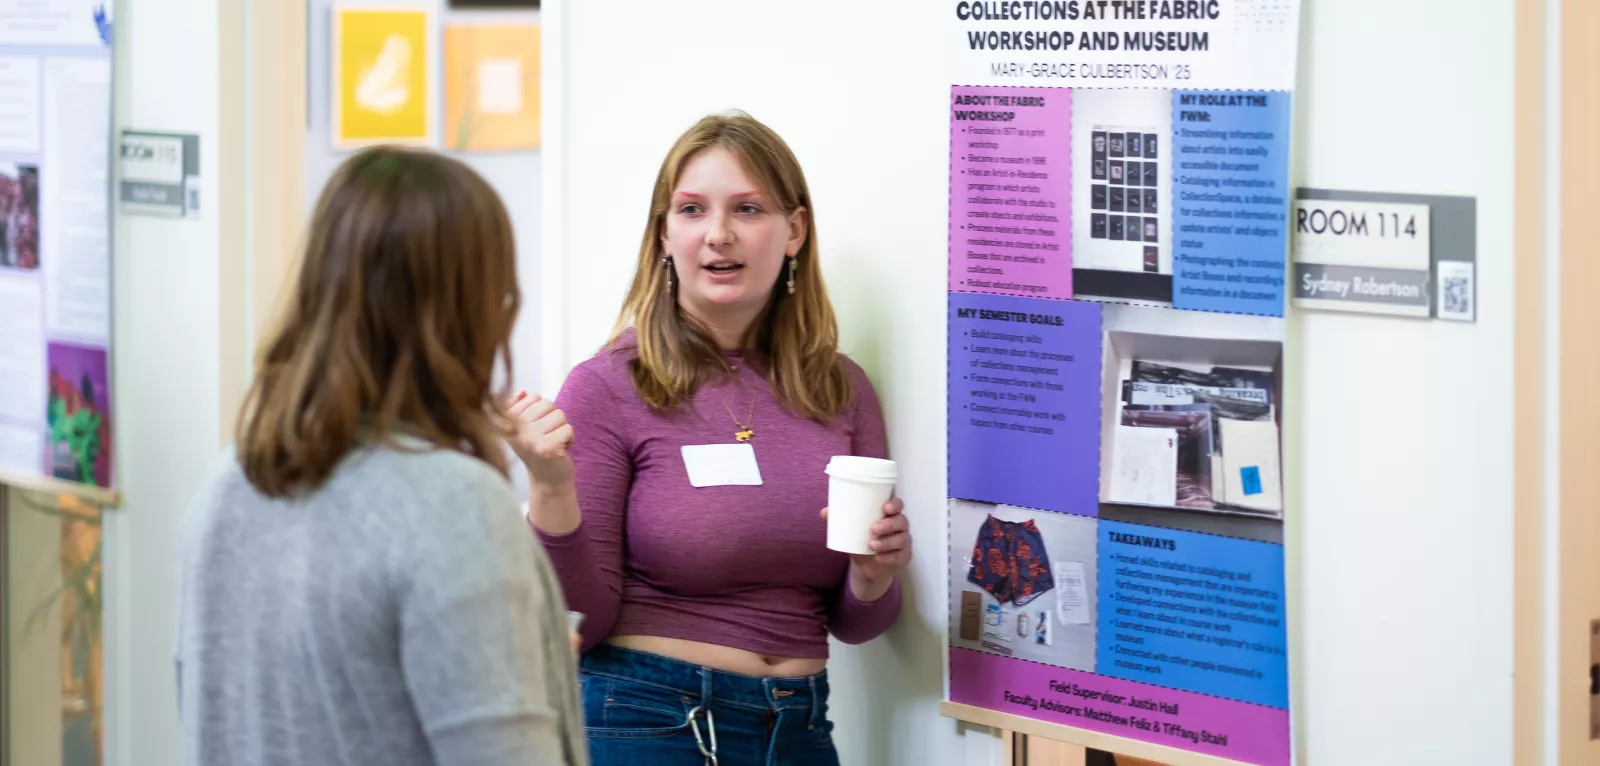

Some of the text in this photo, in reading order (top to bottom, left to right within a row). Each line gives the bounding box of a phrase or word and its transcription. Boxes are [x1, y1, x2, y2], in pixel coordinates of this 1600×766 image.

[956, 0, 1220, 20] COLLECTIONS AT THE FABRIC
[968, 30, 1209, 51] WORKSHOP AND MUSEUM
[990, 62, 1076, 78] MARY-GRACE
[1080, 63, 1168, 79] CULBERTSON
[954, 95, 1045, 107] ABOUT THE FABRIC
[1180, 94, 1268, 107] MY ROLE AT THE
[954, 111, 1015, 121] WORKSHOP
[1180, 110, 1211, 122] FWM:
[1297, 208, 1416, 239] ROOM 114
[1302, 273, 1420, 298] Sydney Robertson
[957, 308, 1064, 326] MY SEMESTER GOALS:
[1108, 531, 1176, 551] TAKEAWAYS
[1049, 680, 1179, 716] Field Supervisor: Justin Hall
[1004, 691, 1228, 746] Faculty Advisors: Matthew Feliz & Tiffany Stahl
